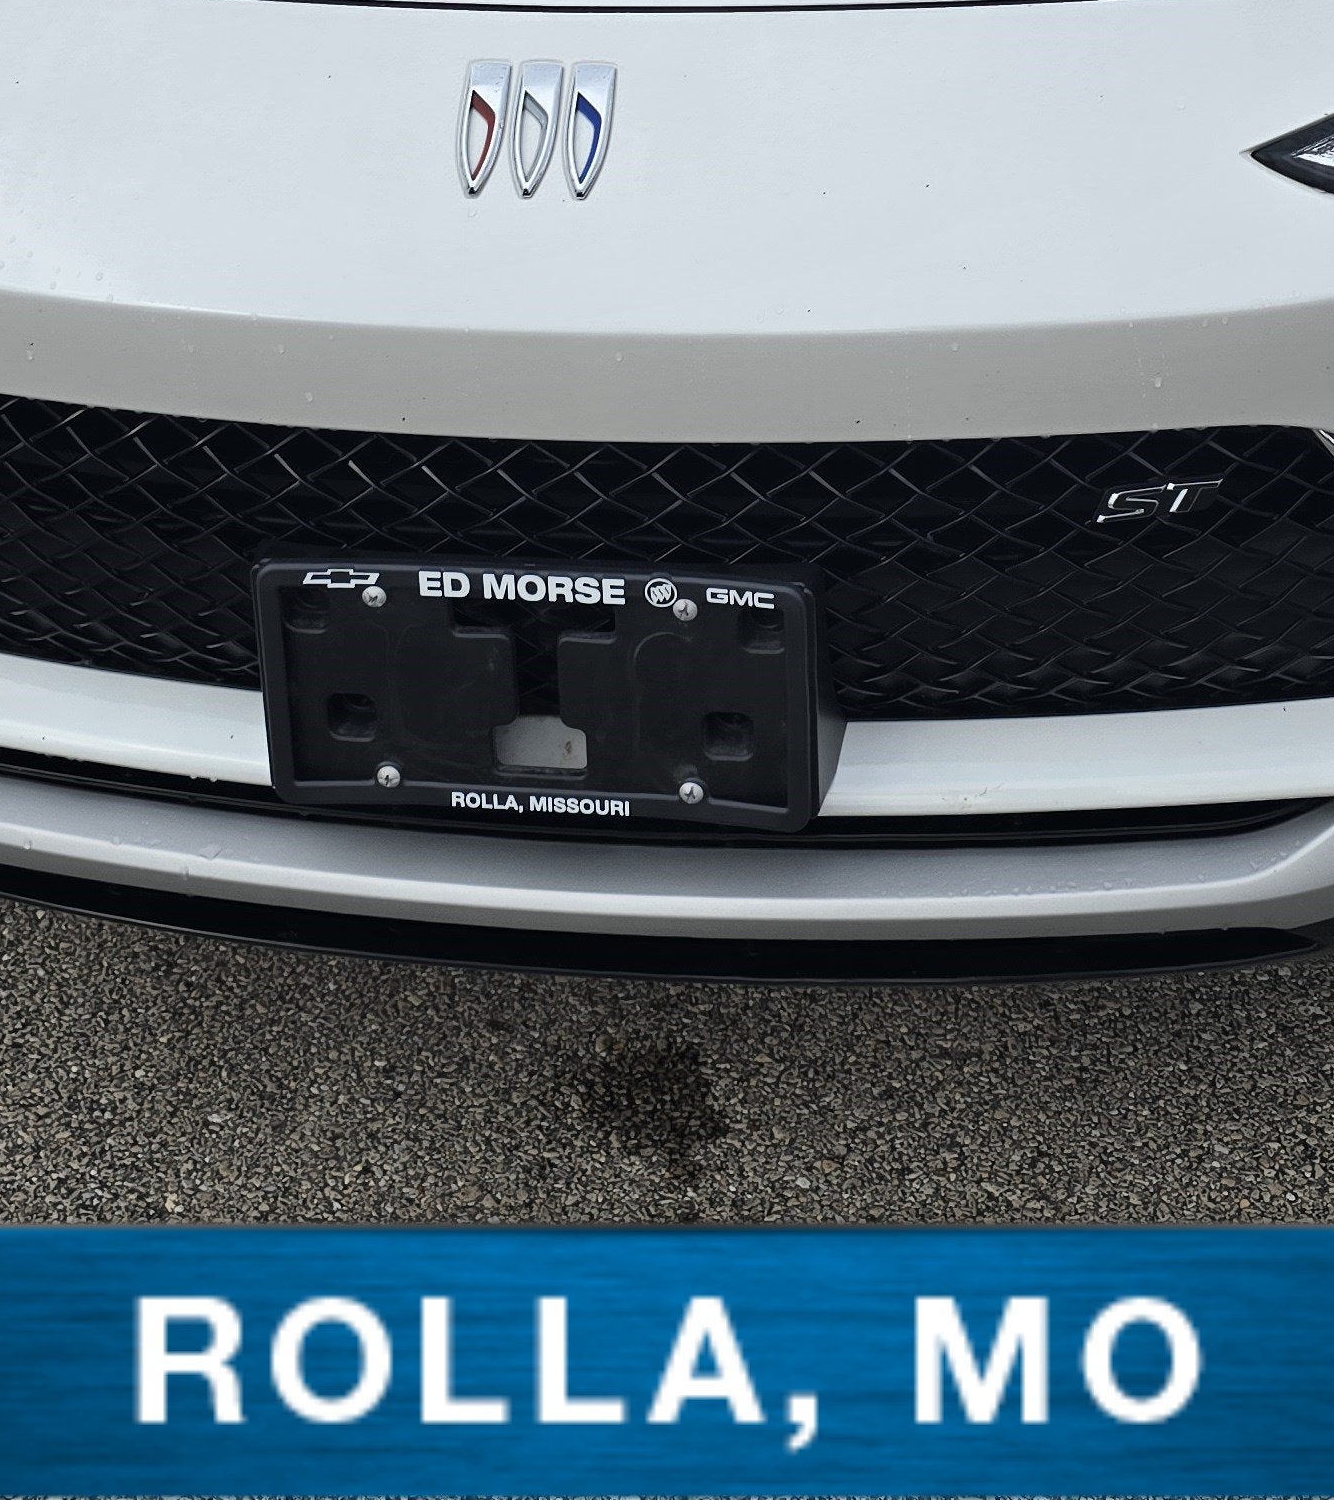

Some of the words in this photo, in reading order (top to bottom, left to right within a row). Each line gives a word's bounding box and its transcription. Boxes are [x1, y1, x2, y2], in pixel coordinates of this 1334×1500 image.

[1096, 479, 1223, 524] ST
[418, 570, 471, 598] ED
[482, 573, 626, 606] MORSE
[704, 586, 776, 610] GMC
[450, 791, 525, 814] ROLLA,
[529, 795, 631, 817] MISSOURI
